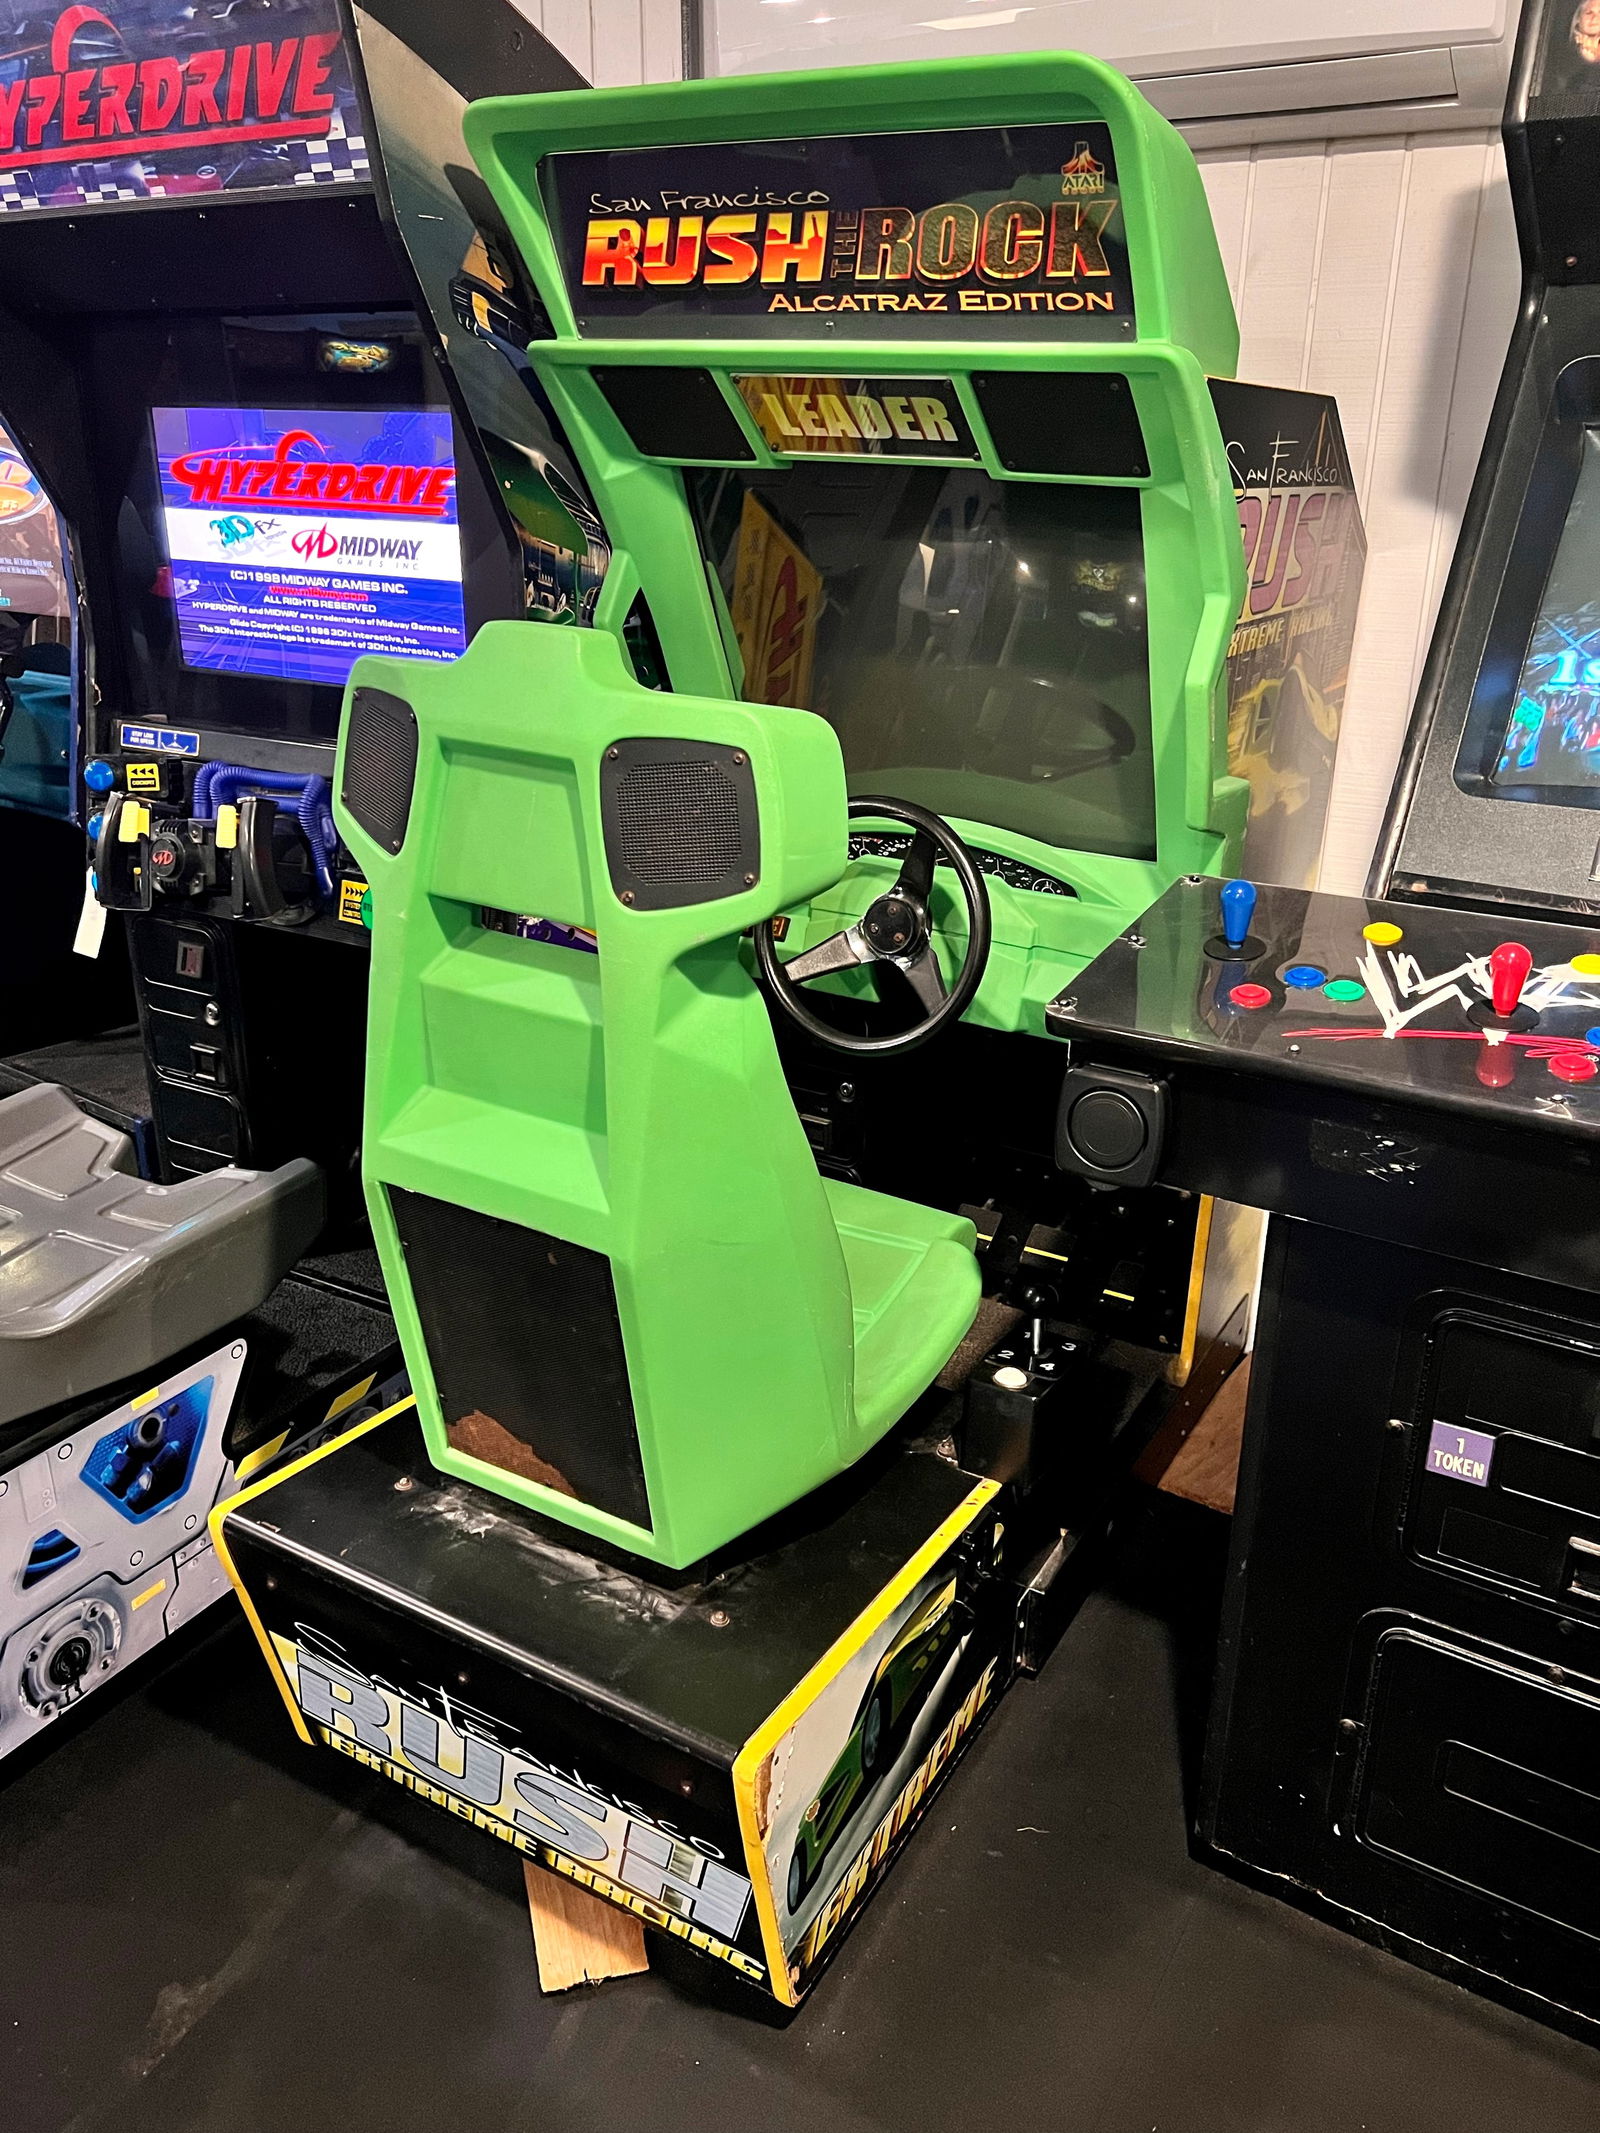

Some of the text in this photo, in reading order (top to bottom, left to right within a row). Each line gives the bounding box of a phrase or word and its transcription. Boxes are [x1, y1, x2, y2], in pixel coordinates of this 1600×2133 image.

[0, 31, 341, 149] YPERDRIVE
[1062, 173, 1104, 188] ATARI
[588, 186, 830, 214] San Francisco
[582, 200, 1118, 288] RUSH THE ROCK
[767, 290, 1115, 313] ALCATRAZ EDITION
[762, 393, 959, 442] LEADER
[172, 454, 458, 508] HYPERDRIVE
[338, 535, 423, 561] MIDWAY
[337, 557, 384, 569] GAMES
[281, 574, 330, 588] MIDWAY
[332, 578, 380, 593] GAMES
[381, 582, 408, 595] INC.
[263, 595, 377, 613] ALL RIGHTS RESERVED
[192, 601, 248, 614] HYPERDRIVE
[248, 608, 263, 616] and
[264, 608, 299, 619] MIDWAY
[315, 613, 365, 626] trademarks
[366, 618, 376, 626] of
[376, 618, 410, 631] Midway
[411, 622, 443, 633] Games
[443, 625, 460, 635] Inc.
[199, 623, 214, 633] The
[311, 636, 357, 649] trademark
[358, 640, 367, 649] of
[367, 641, 389, 652] 3Dfx
[250, 621, 290, 634] Copyright
[291, 624, 304, 634] (C)
[331, 628, 352, 638] 3Dfx
[404, 635, 420, 645] Inc.
[1226, 616, 1286, 658] XTREME
[997, 1349, 1015, 1360] 2
[1061, 1342, 1077, 1351] 3
[1039, 1362, 1056, 1372] 4
[1456, 1437, 1465, 1455] 1
[1433, 1449, 1485, 1480] TOKEN
[295, 1647, 753, 1942] RUSH
[322, 1728, 766, 1981] EXTREME RACING
